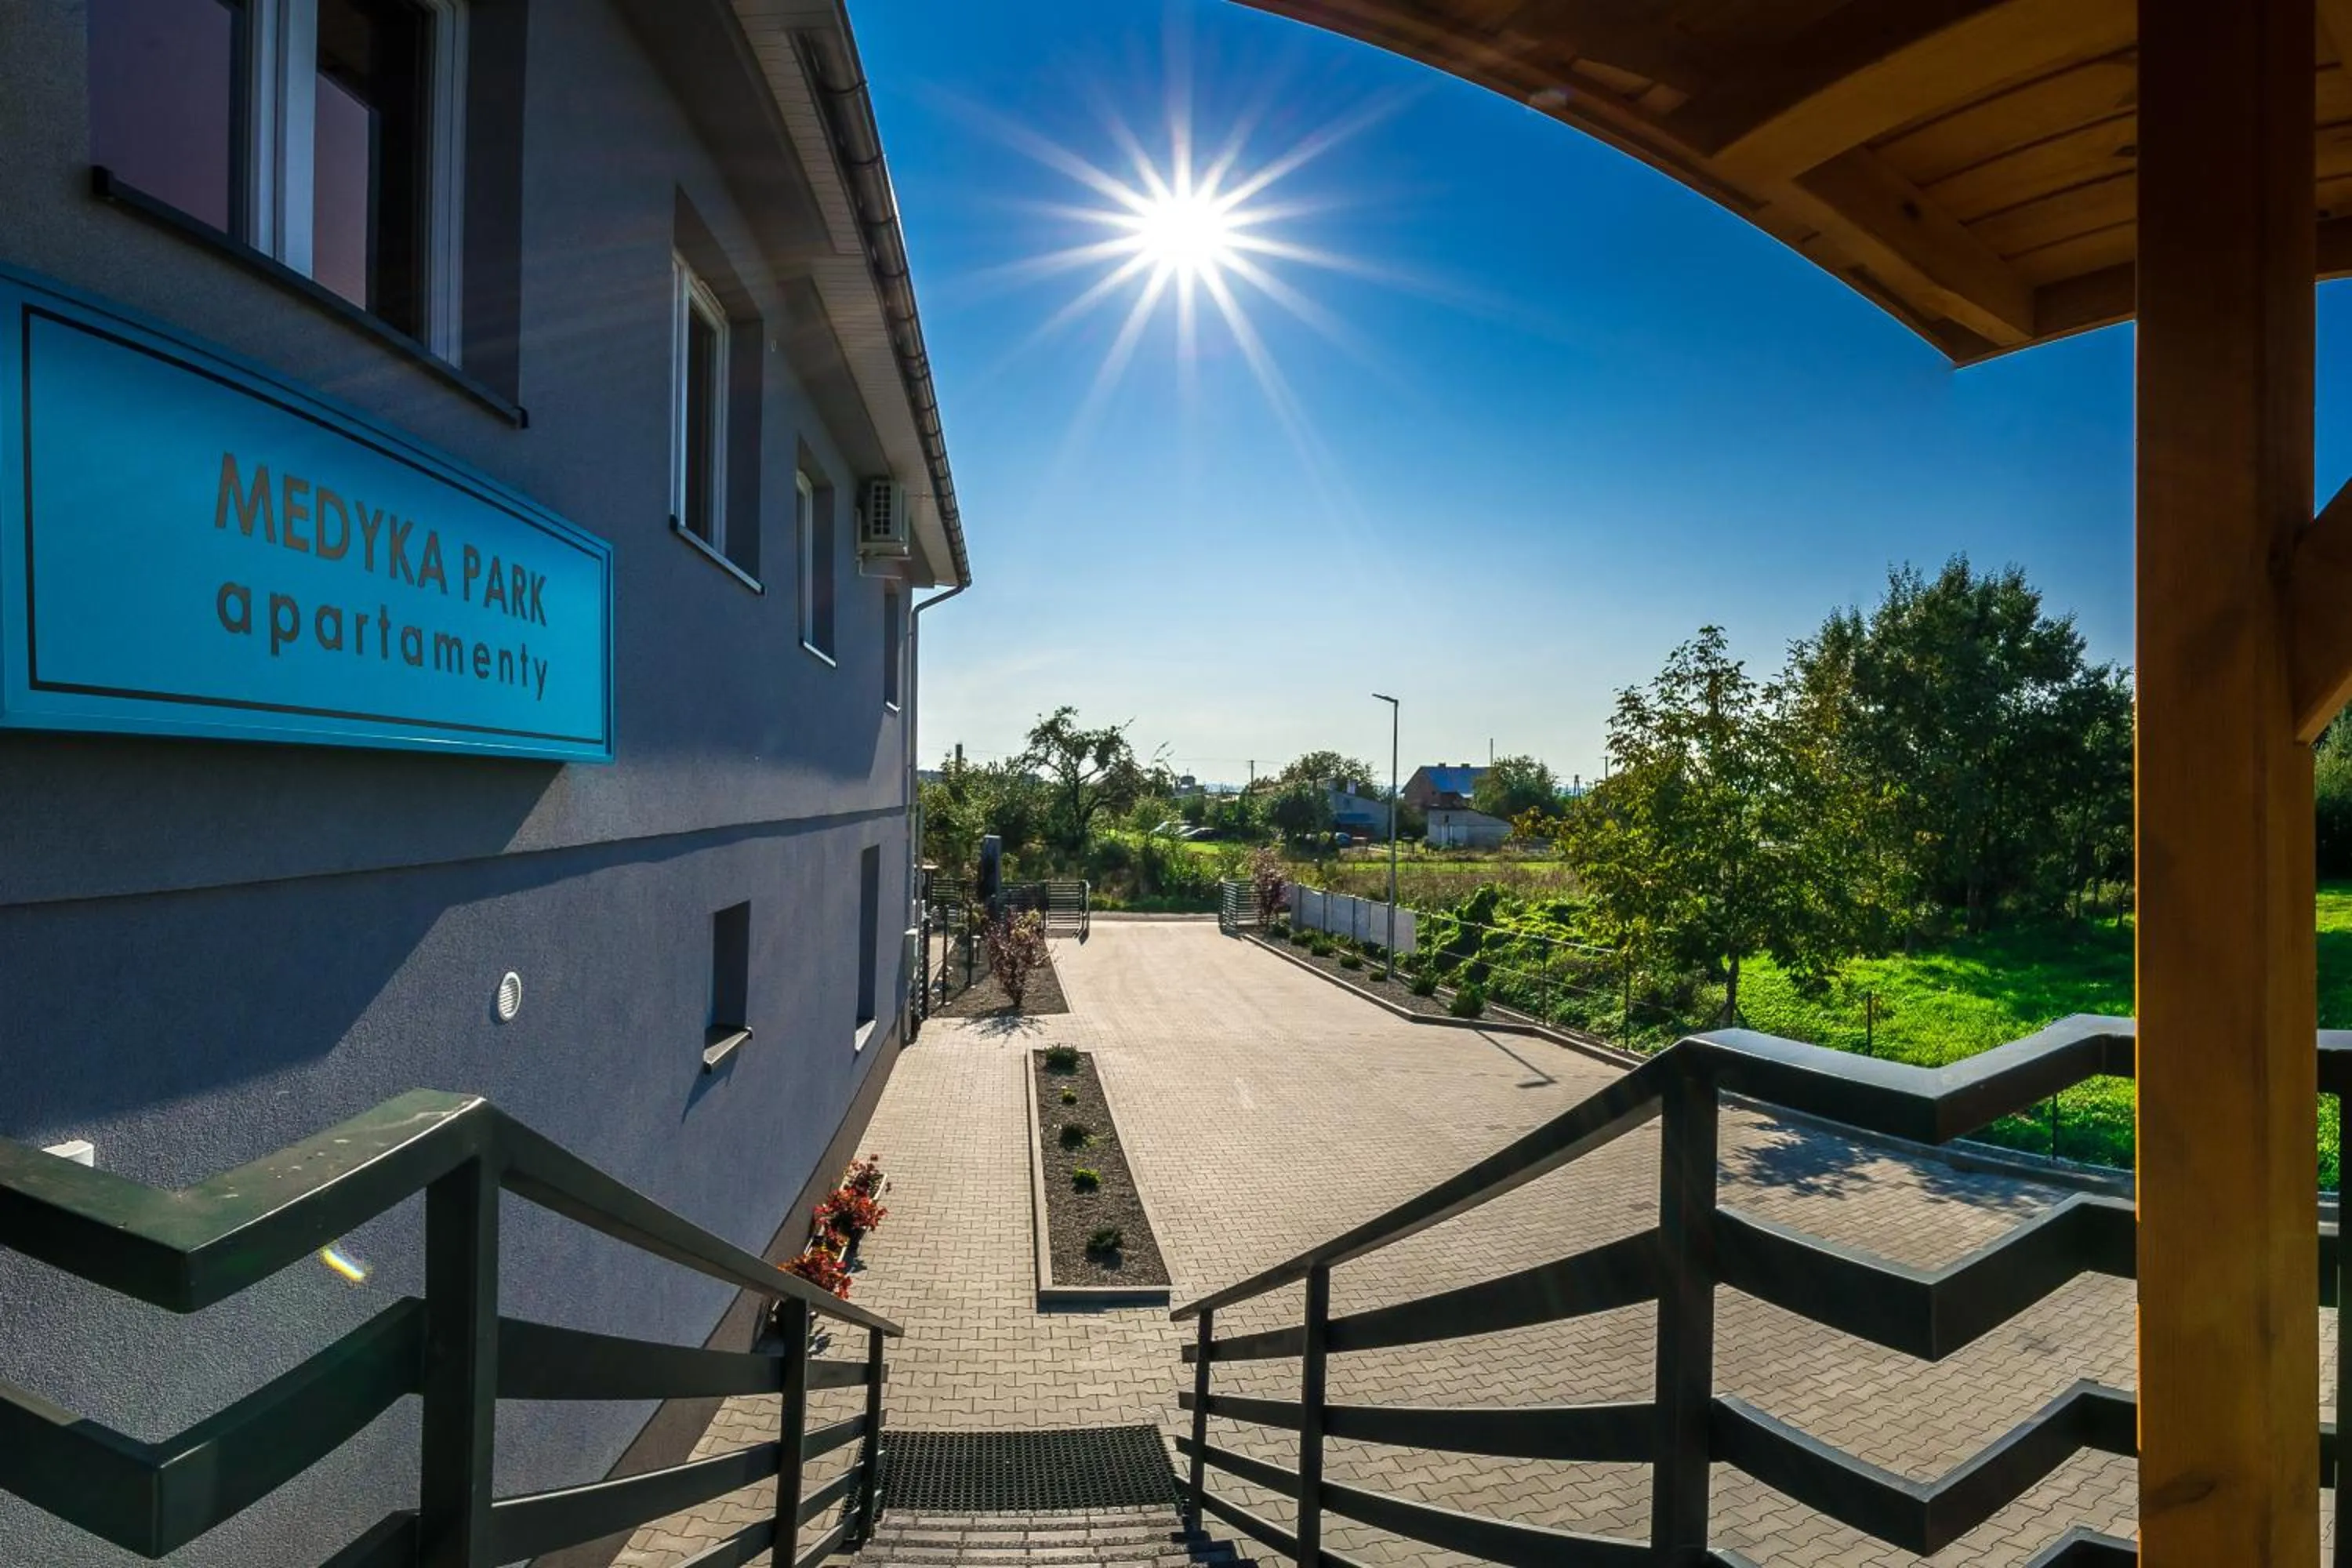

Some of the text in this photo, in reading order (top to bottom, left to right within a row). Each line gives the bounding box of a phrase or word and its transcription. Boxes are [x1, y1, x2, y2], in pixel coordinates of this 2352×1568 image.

[215, 452, 546, 626] MEDYKA PARK
[217, 582, 547, 700] apartamenty
